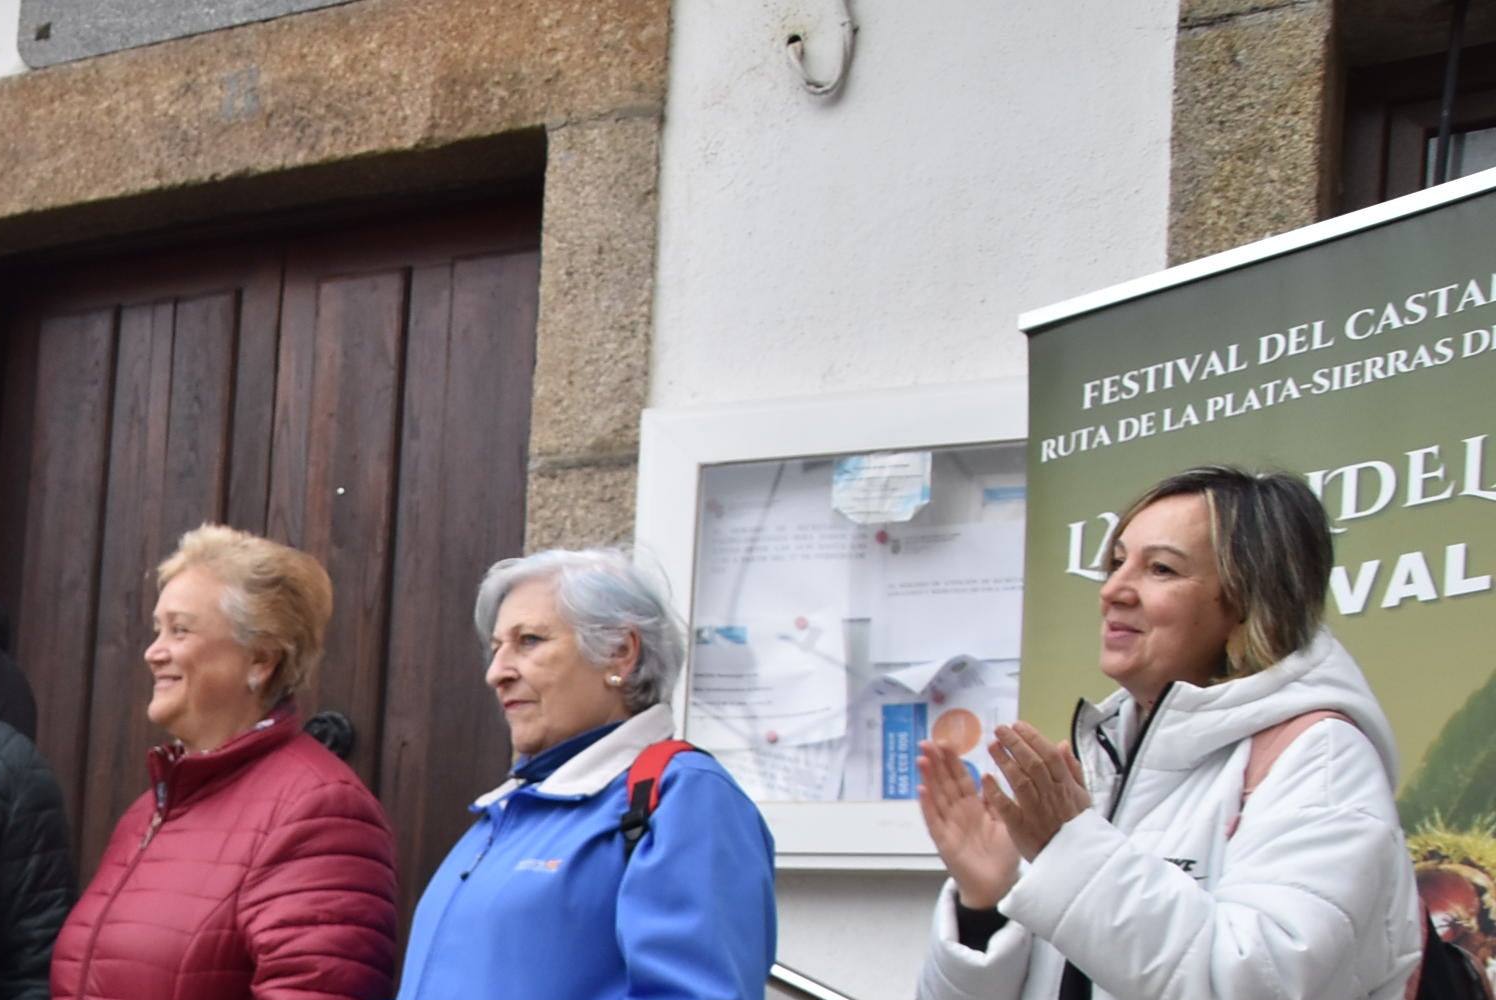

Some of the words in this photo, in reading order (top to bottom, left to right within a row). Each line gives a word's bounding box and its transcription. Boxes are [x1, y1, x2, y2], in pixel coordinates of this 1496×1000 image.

[1040, 425, 1112, 463] RUTA
[1118, 412, 1156, 443] DE
[1163, 404, 1200, 431] LA
[1205, 337, 1454, 422] PLATA-SIERRAS
[1081, 344, 1249, 410] FESTIVAL
[1258, 320, 1335, 365] DEL
[1344, 273, 1496, 340] CASTA
[1304, 434, 1496, 534] DEL
